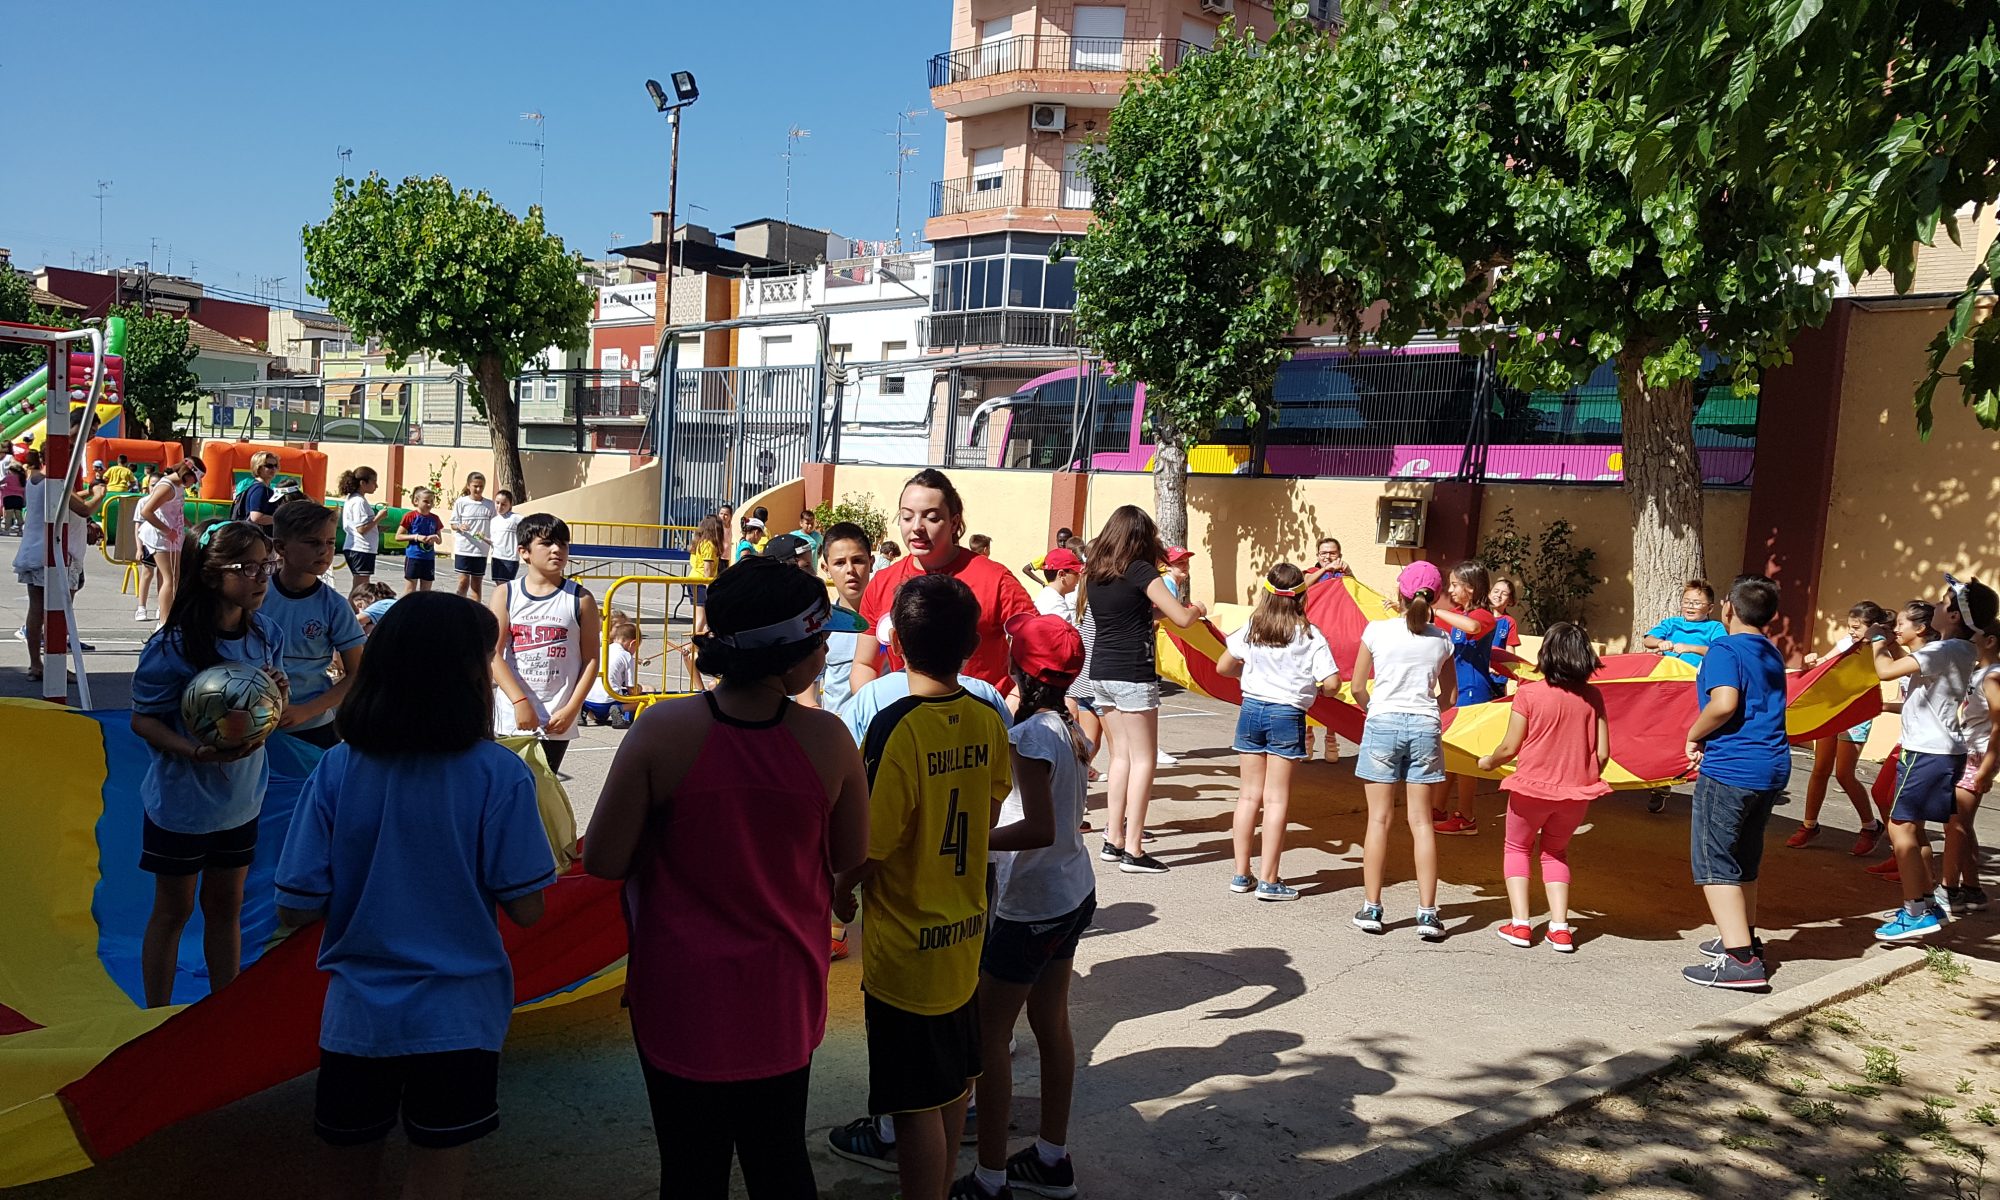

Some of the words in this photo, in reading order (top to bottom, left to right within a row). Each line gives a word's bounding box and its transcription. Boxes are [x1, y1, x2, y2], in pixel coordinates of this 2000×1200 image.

[541, 615, 562, 623] SPIRIT
[535, 626, 568, 643] STATE
[546, 646, 567, 658] 1973
[948, 713, 960, 725] BVB
[927, 744, 988, 777] GUILLEM
[939, 788, 969, 877] 4
